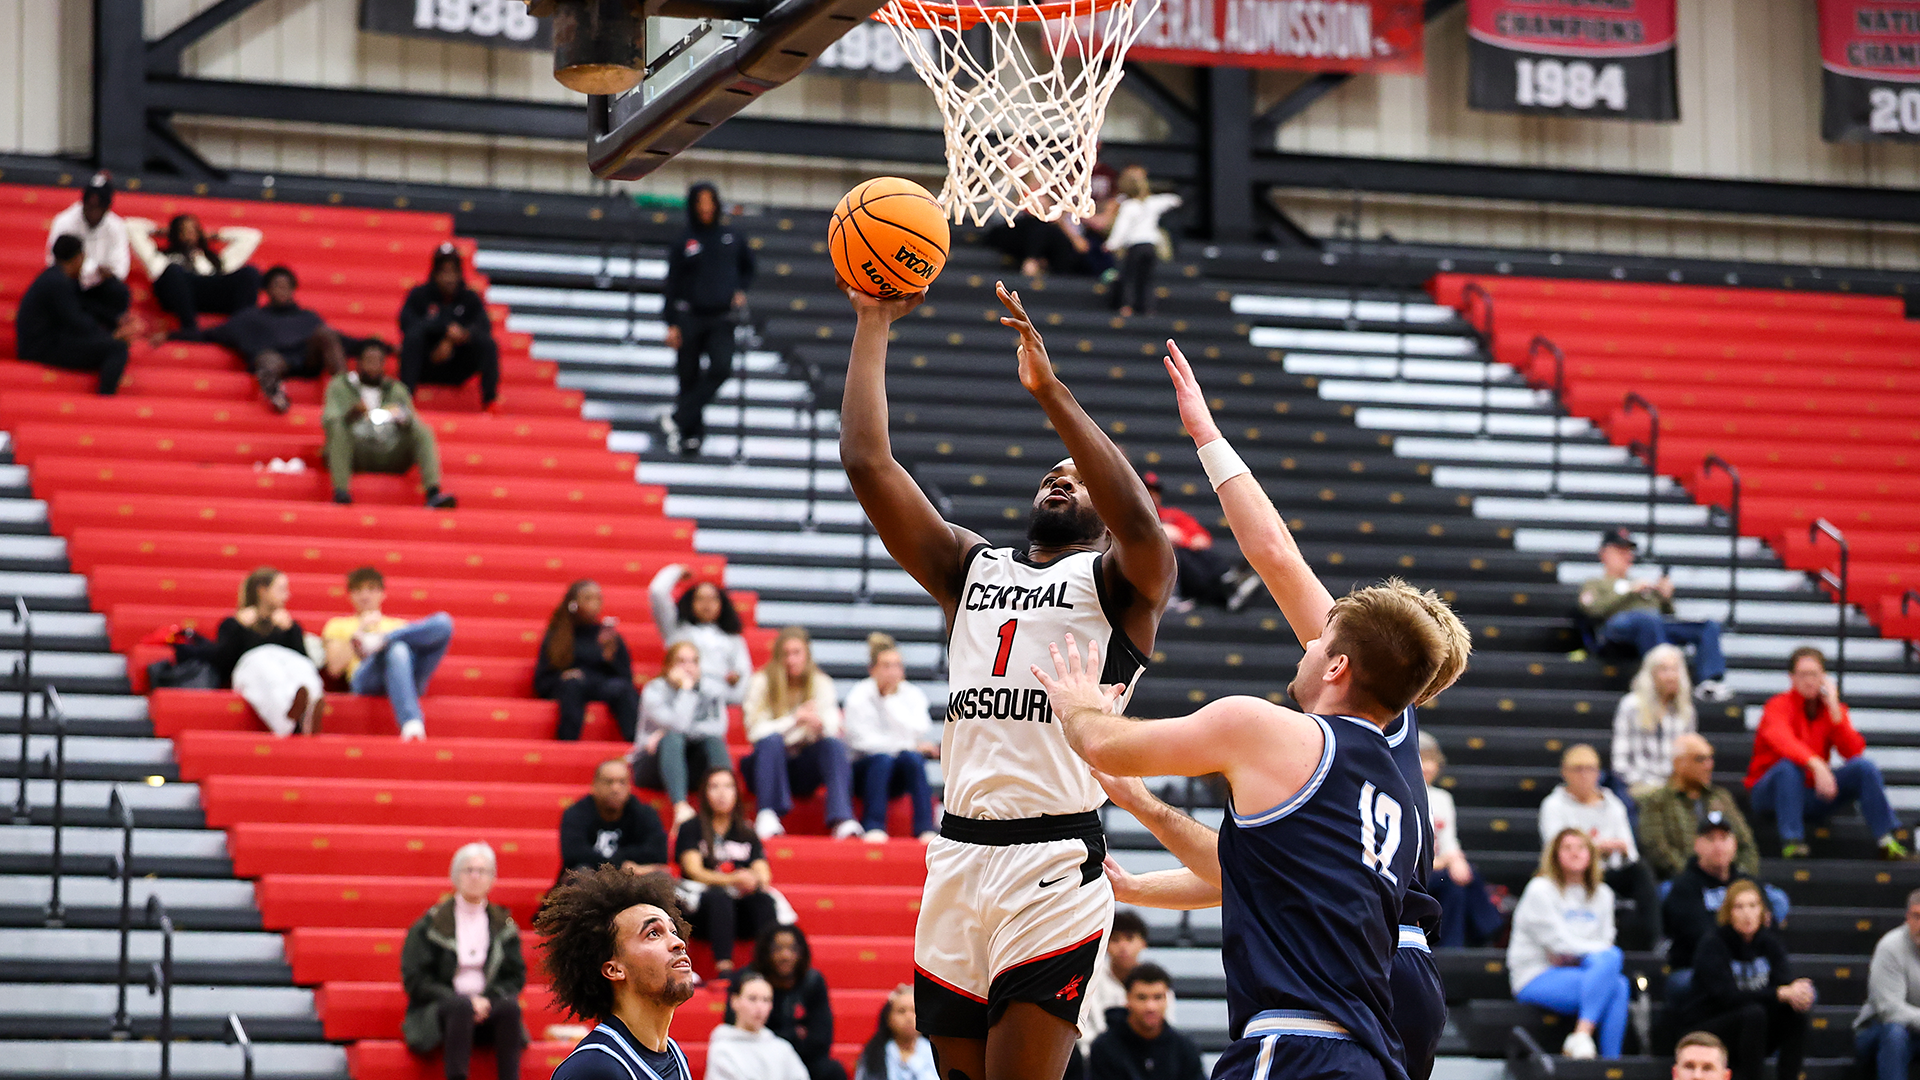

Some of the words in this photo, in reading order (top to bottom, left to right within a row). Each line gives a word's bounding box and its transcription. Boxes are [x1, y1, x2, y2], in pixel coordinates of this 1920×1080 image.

[1224, 0, 1372, 60] ADMISSION
[1495, 10, 1646, 44] CHAMPIONS
[1857, 8, 1920, 34] NATI
[1847, 41, 1920, 66] CHAM
[1515, 57, 1628, 110] 1984
[894, 244, 937, 280] NCAA
[965, 580, 1074, 612] CENTRAL
[991, 618, 1018, 677] 1
[1358, 780, 1403, 887] 12
